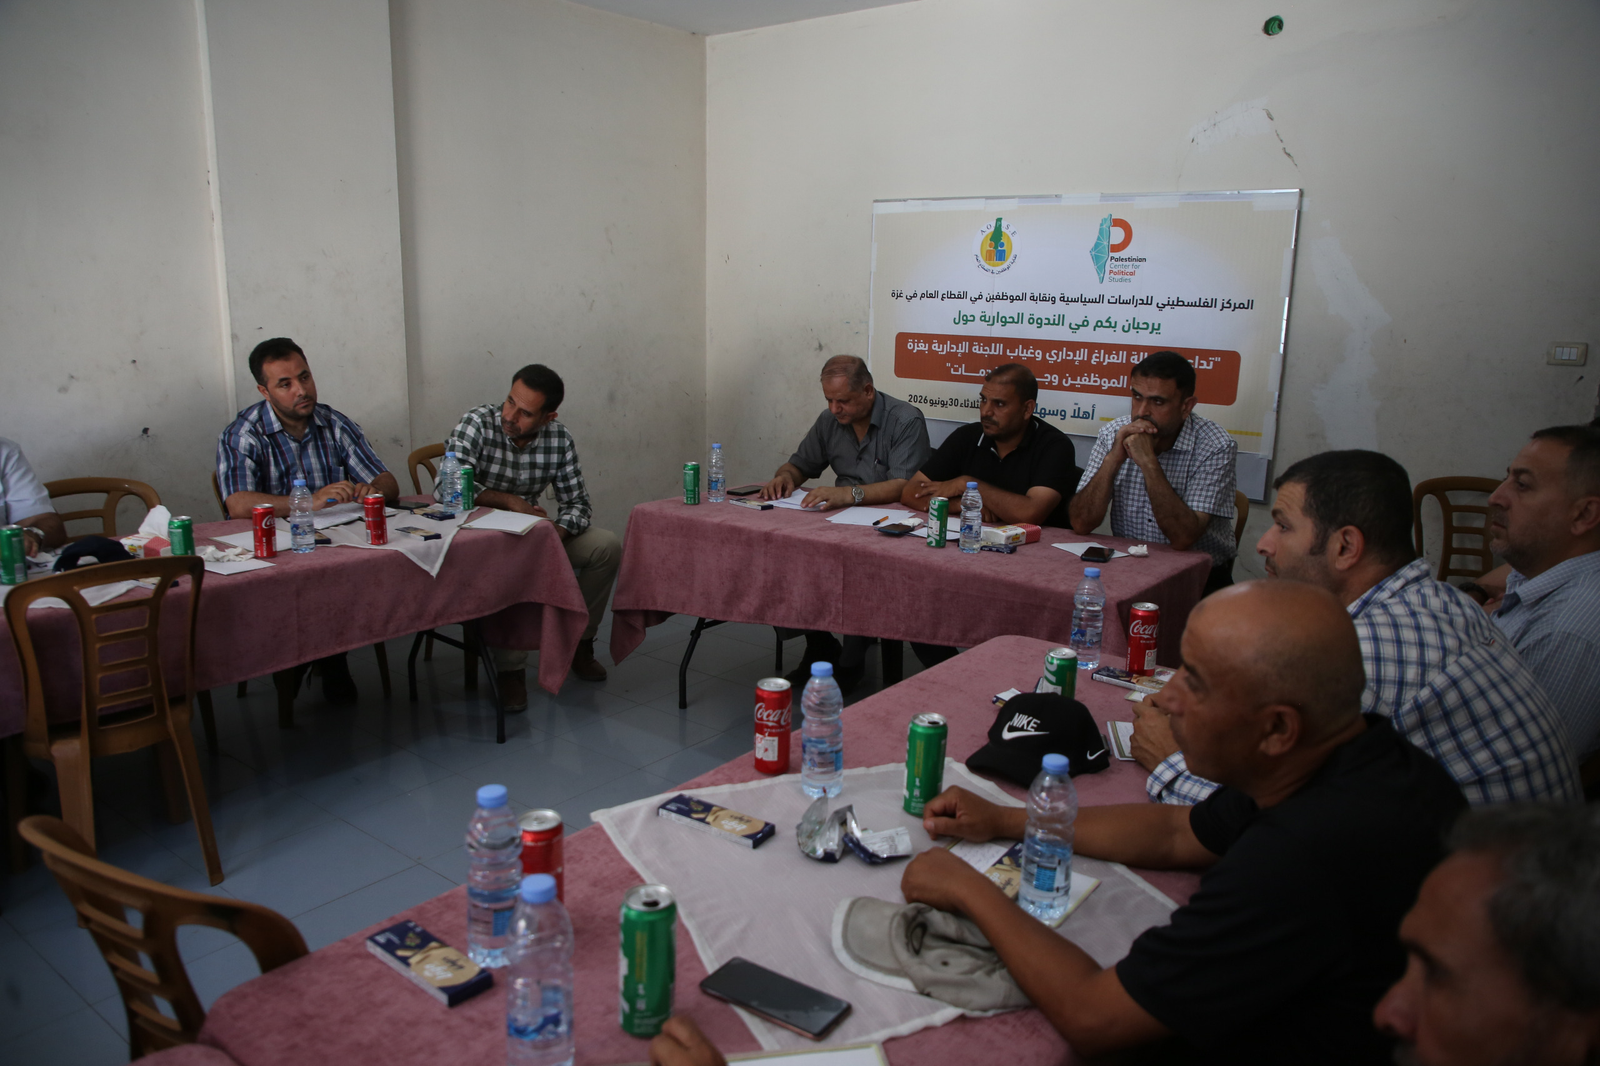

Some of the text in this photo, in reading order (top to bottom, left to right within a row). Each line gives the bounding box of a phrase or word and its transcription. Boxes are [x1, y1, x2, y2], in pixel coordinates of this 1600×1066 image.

[890, 289, 1254, 312] المركز الفلسطيني للدراسات السياسية ونقابة الموظفين في القطاع العام في غزة
[953, 310, 1162, 335] يرحبان بكم في الندوة الحوارية حول
[907, 338, 929, 354] بغزة
[931, 339, 969, 357] الإدارية
[972, 340, 1003, 358] اللجنة
[1006, 344, 1043, 361] وغياب
[1045, 346, 1088, 364] الإداري
[1091, 349, 1127, 366] الفراغ
[1130, 351, 1148, 365] الة
[908, 394, 928, 404] 2026
[1010, 712, 1041, 732] NIKE
